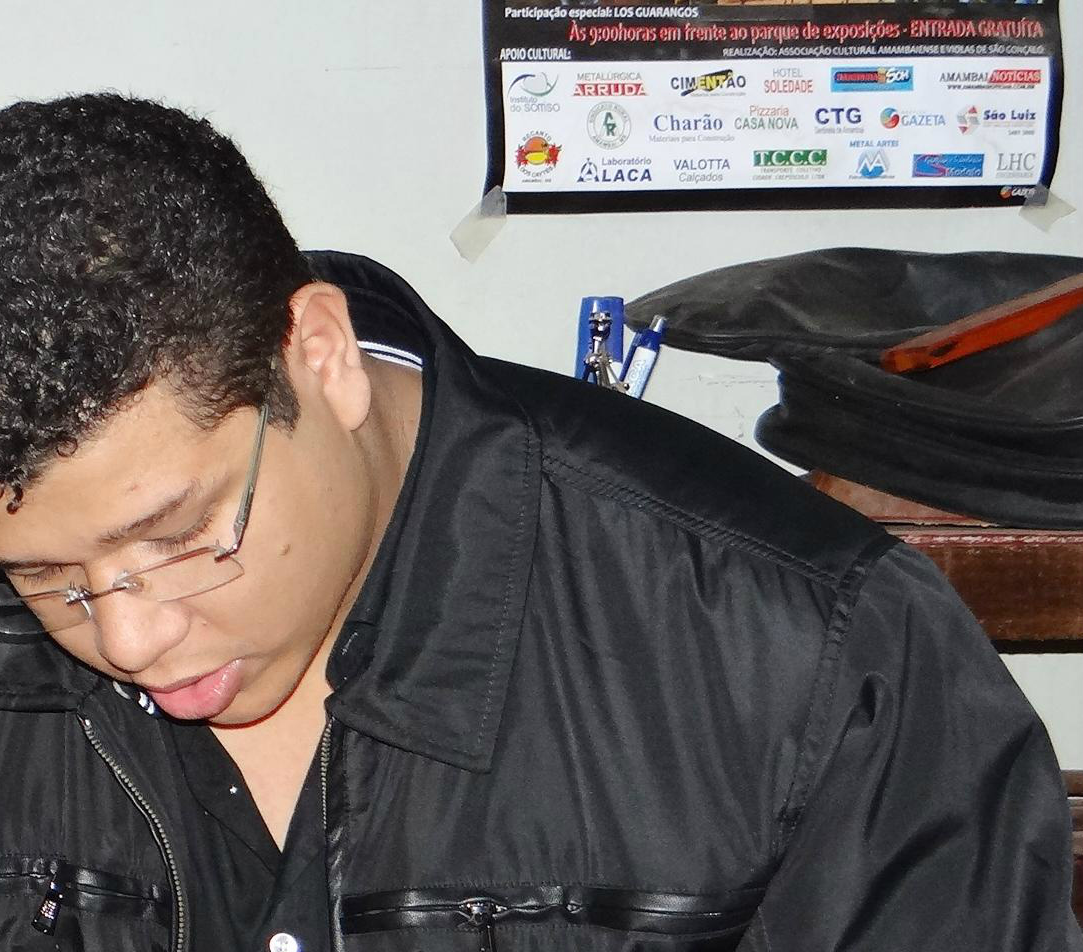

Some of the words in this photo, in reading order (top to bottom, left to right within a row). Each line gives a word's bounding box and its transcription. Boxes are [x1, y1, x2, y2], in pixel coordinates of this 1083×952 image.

[505, 6, 567, 21] Participação
[568, 7, 612, 21] especial:
[614, 8, 635, 18] LOS
[635, 7, 699, 18] GUARANGOS
[659, 28, 681, 42] em
[684, 23, 727, 41] frente
[729, 26, 747, 40] ao
[751, 25, 800, 45] parque
[802, 21, 820, 40] de
[822, 19, 900, 44] exposições
[910, 20, 977, 38] ENTRADA
[978, 17, 1044, 38] GRATUÍTA
[500, 48, 526, 60] APOIO
[527, 48, 571, 60] CULTURAL:
[722, 45, 778, 58] REALIZAÇÃO:
[778, 45, 833, 58] ASSOCIAÇÃO
[833, 46, 877, 56] CULTURAL
[976, 45, 988, 54] DE
[988, 42, 1006, 54] SÃO
[576, 71, 643, 81] METALÚRGICA
[772, 68, 803, 78] HOTEL
[939, 72, 989, 82] AMAMBAI
[573, 83, 646, 97] ARRUDA
[764, 79, 813, 94] SOLEDADE
[509, 96, 538, 104] Instituto
[509, 104, 521, 113] do
[749, 104, 790, 116] Pizzaria
[983, 109, 1006, 120] São
[1011, 109, 1036, 120] Luiz
[653, 113, 723, 131] Charão
[814, 107, 862, 125] CTG
[901, 114, 946, 126] GAZETA
[734, 117, 766, 130] CASA
[768, 117, 799, 130] NOVA
[681, 136, 697, 144] para
[697, 134, 735, 144] Construção
[601, 156, 652, 166] Laboratório
[673, 159, 730, 171] VALOTTA
[997, 152, 1036, 171] LHC
[678, 172, 723, 184] Calçados
